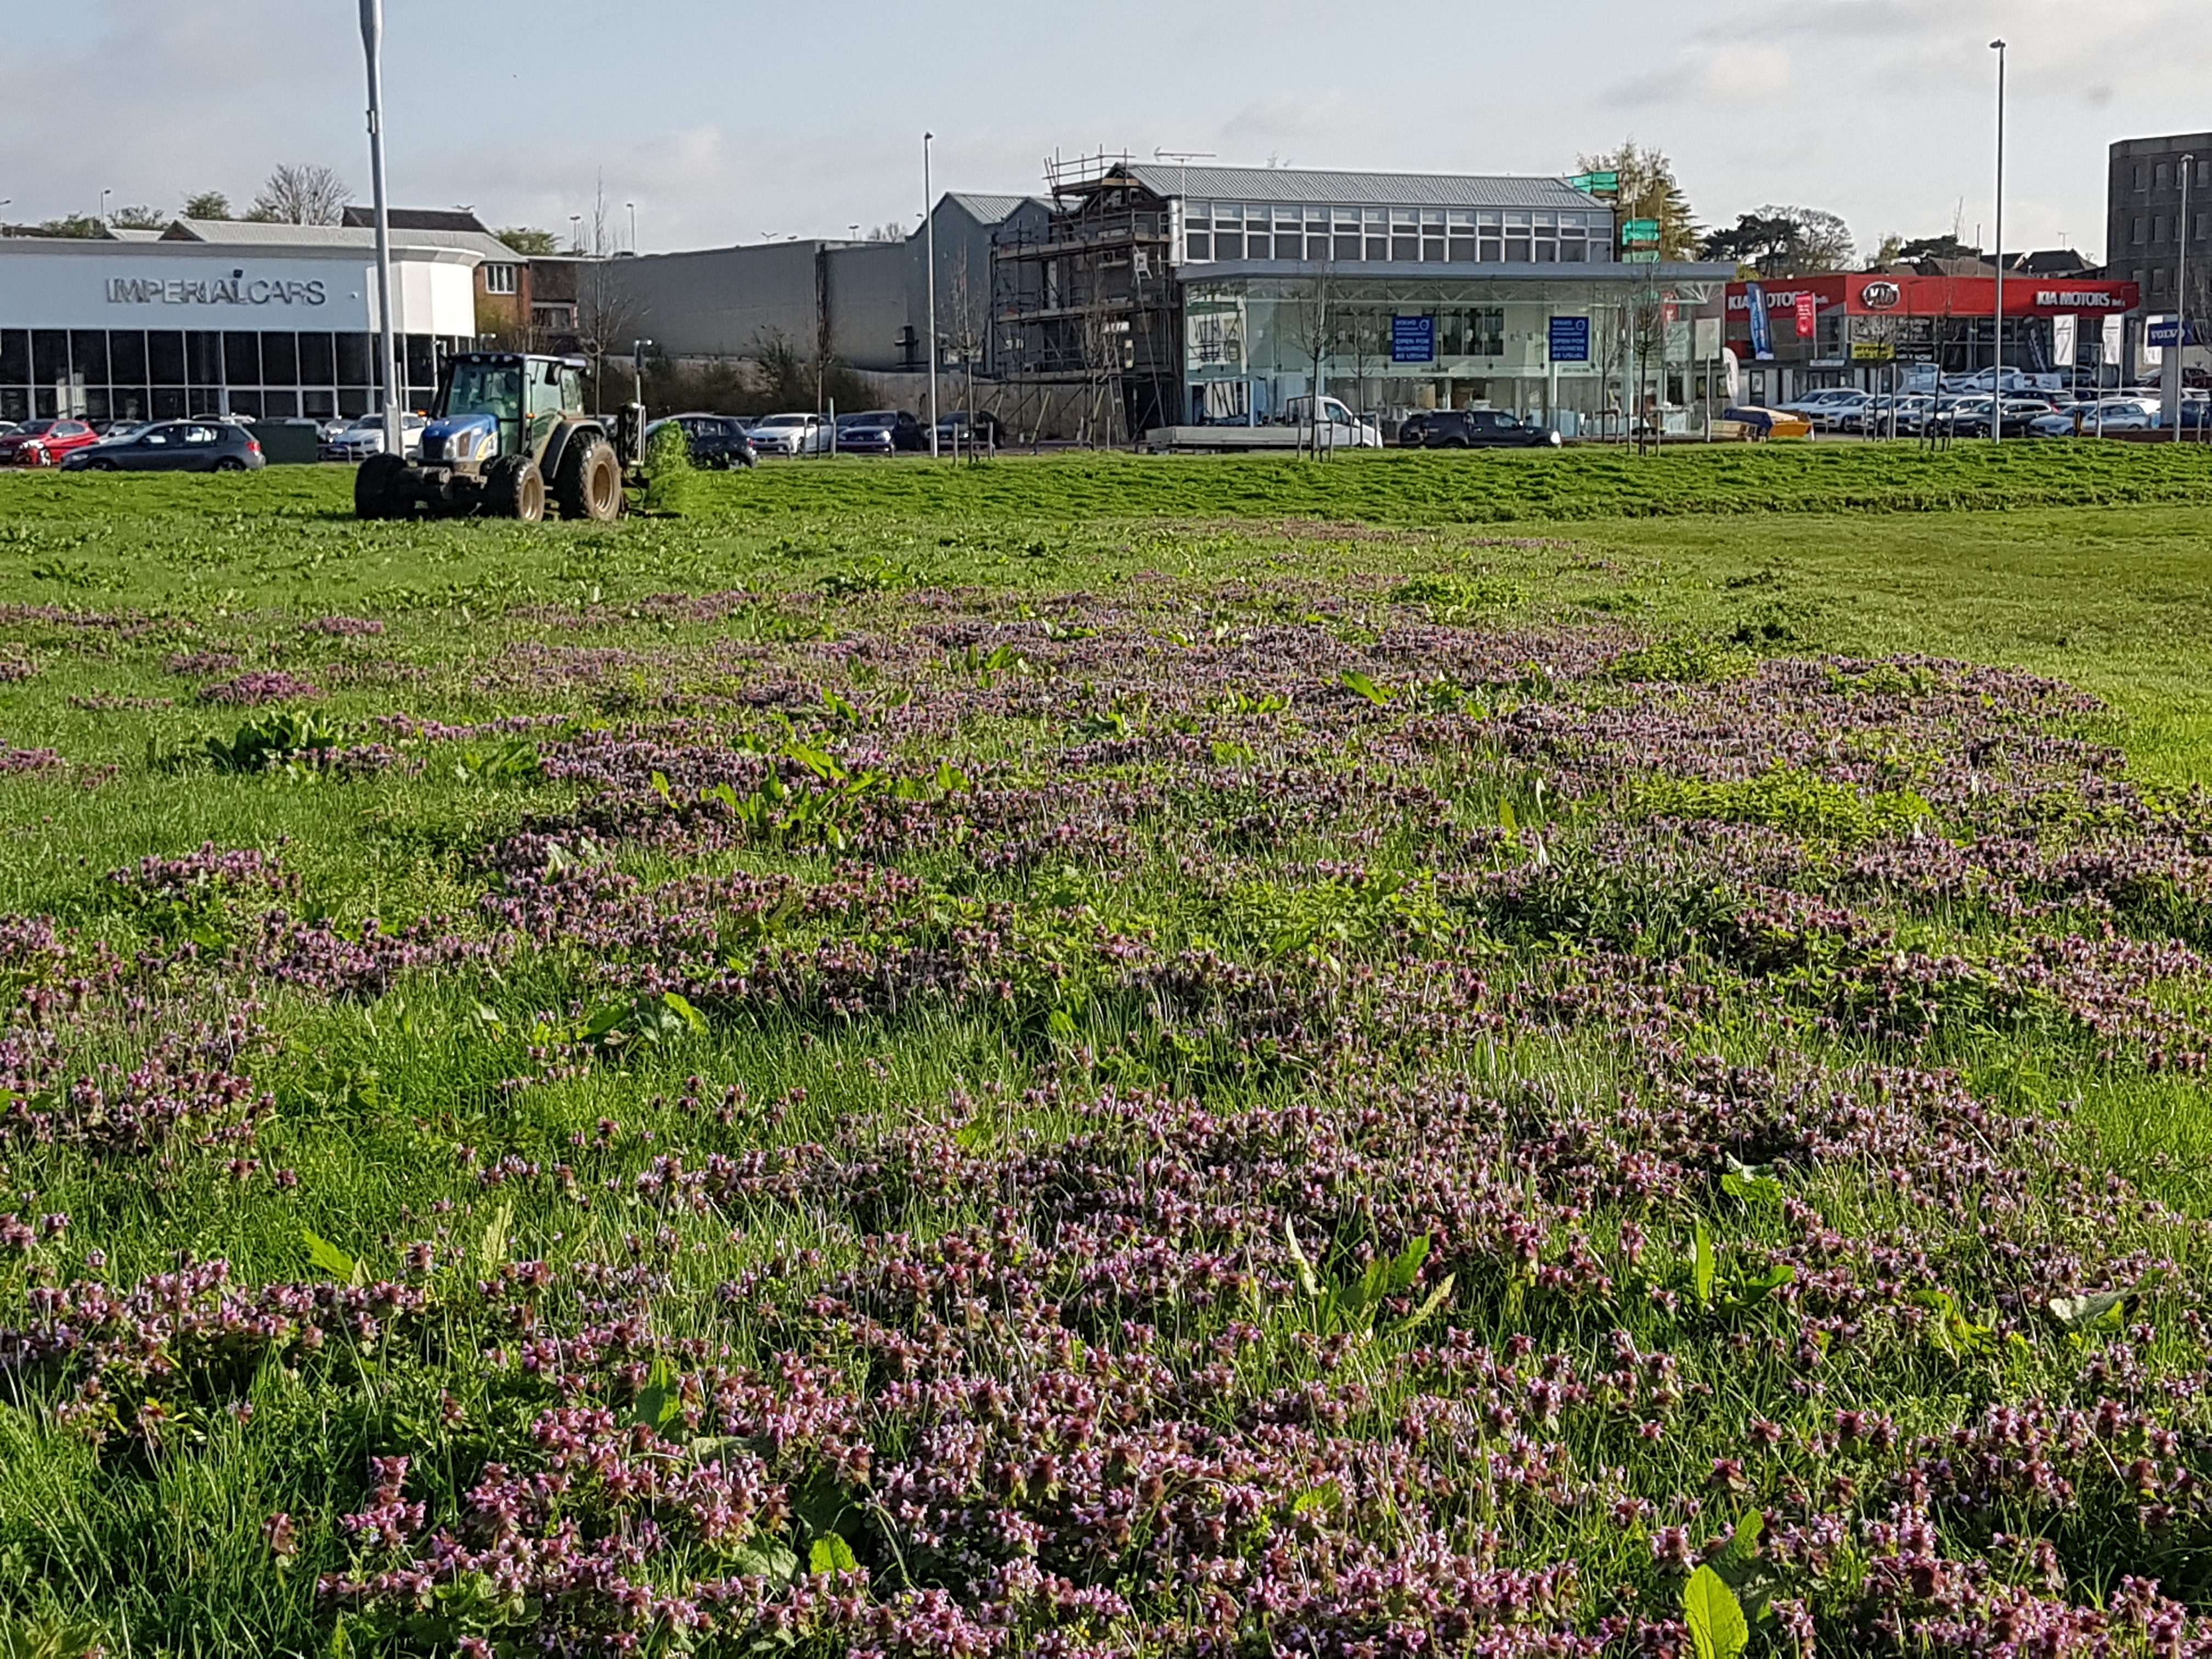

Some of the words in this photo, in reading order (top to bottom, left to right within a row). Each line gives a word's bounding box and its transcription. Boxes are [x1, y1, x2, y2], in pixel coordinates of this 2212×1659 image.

[106, 278, 249, 304] IMPERIAL
[250, 280, 326, 304] CARS
[1728, 295, 1750, 310] KIA
[1766, 291, 1810, 308] OTOR
[2036, 291, 2057, 306] KIA
[2059, 291, 2110, 307] MOTORS
